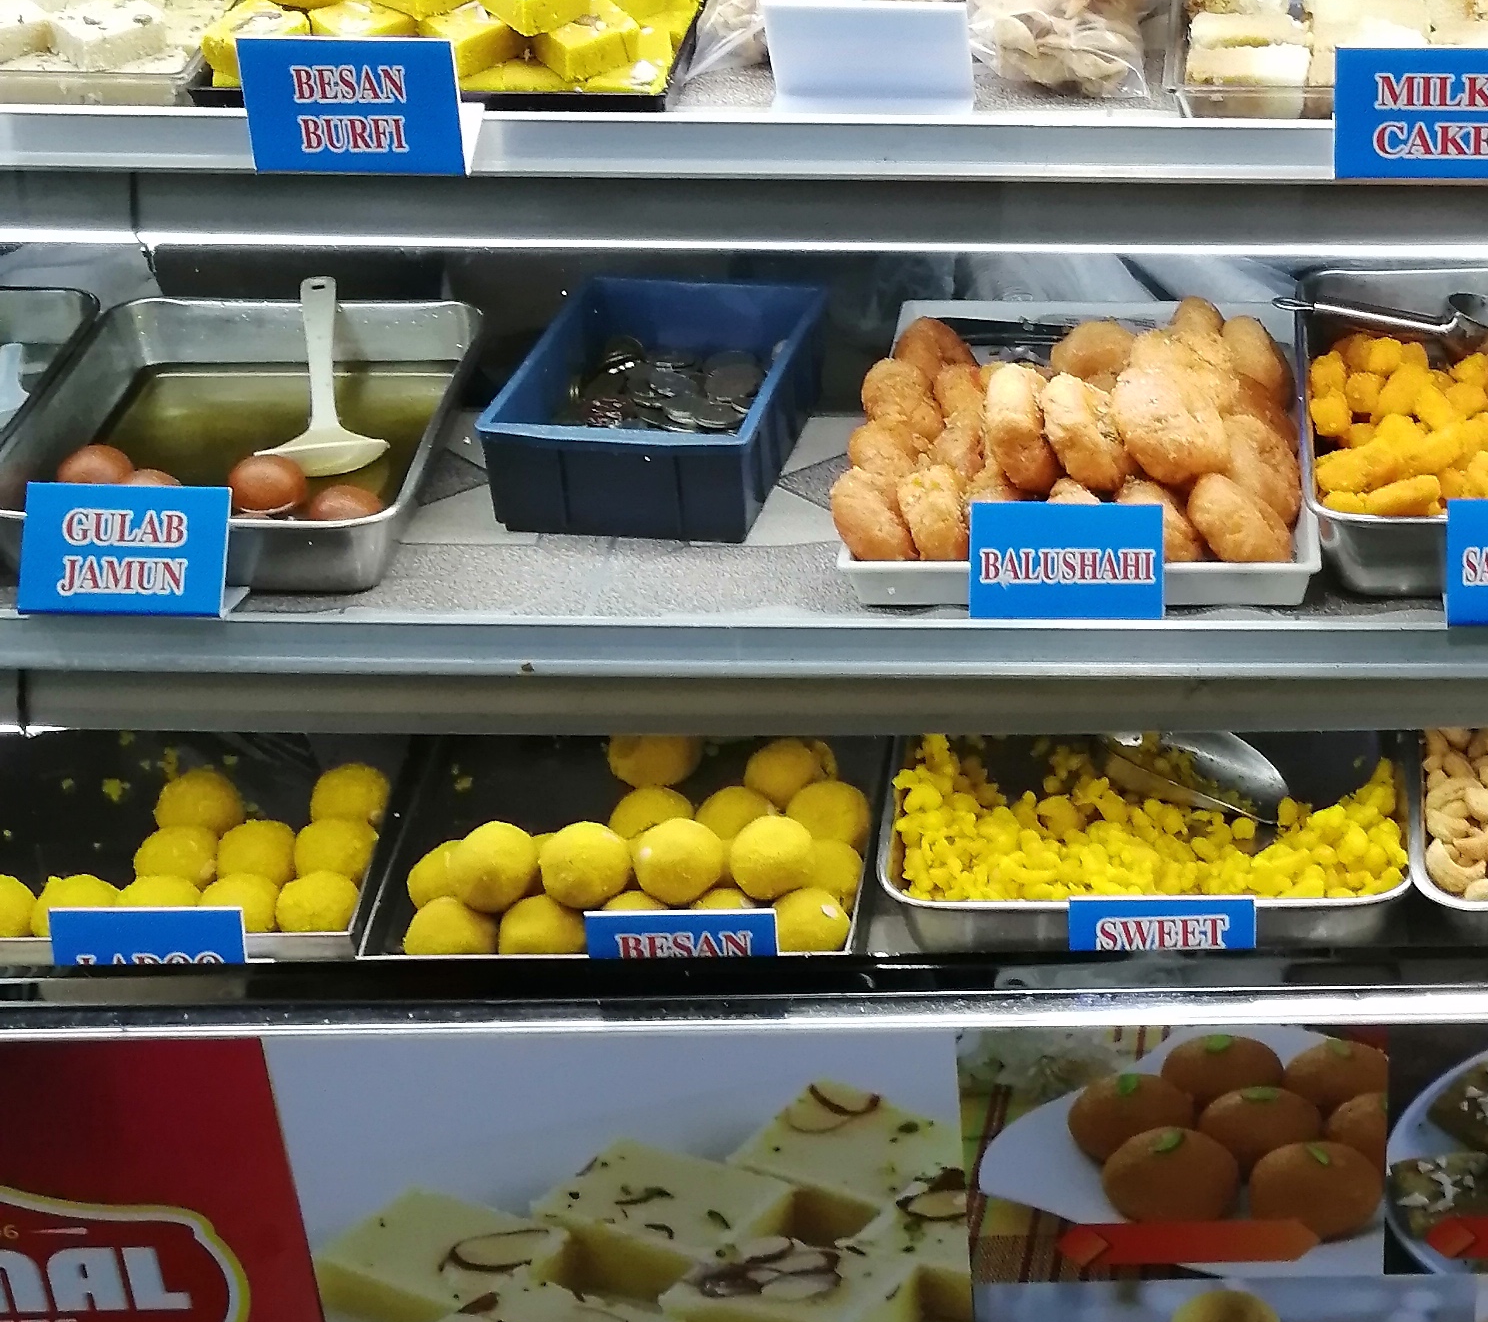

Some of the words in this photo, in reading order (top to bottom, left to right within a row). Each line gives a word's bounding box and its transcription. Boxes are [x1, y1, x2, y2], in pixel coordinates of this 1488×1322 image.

[291, 66, 406, 102] BESAN
[299, 116, 408, 151] BURFI
[64, 509, 186, 546] GULAB
[59, 557, 187, 594] JAMUN
[981, 549, 1155, 583] BALUSHAHI
[615, 931, 752, 958] BESAN
[1097, 915, 1229, 950] SWEET
